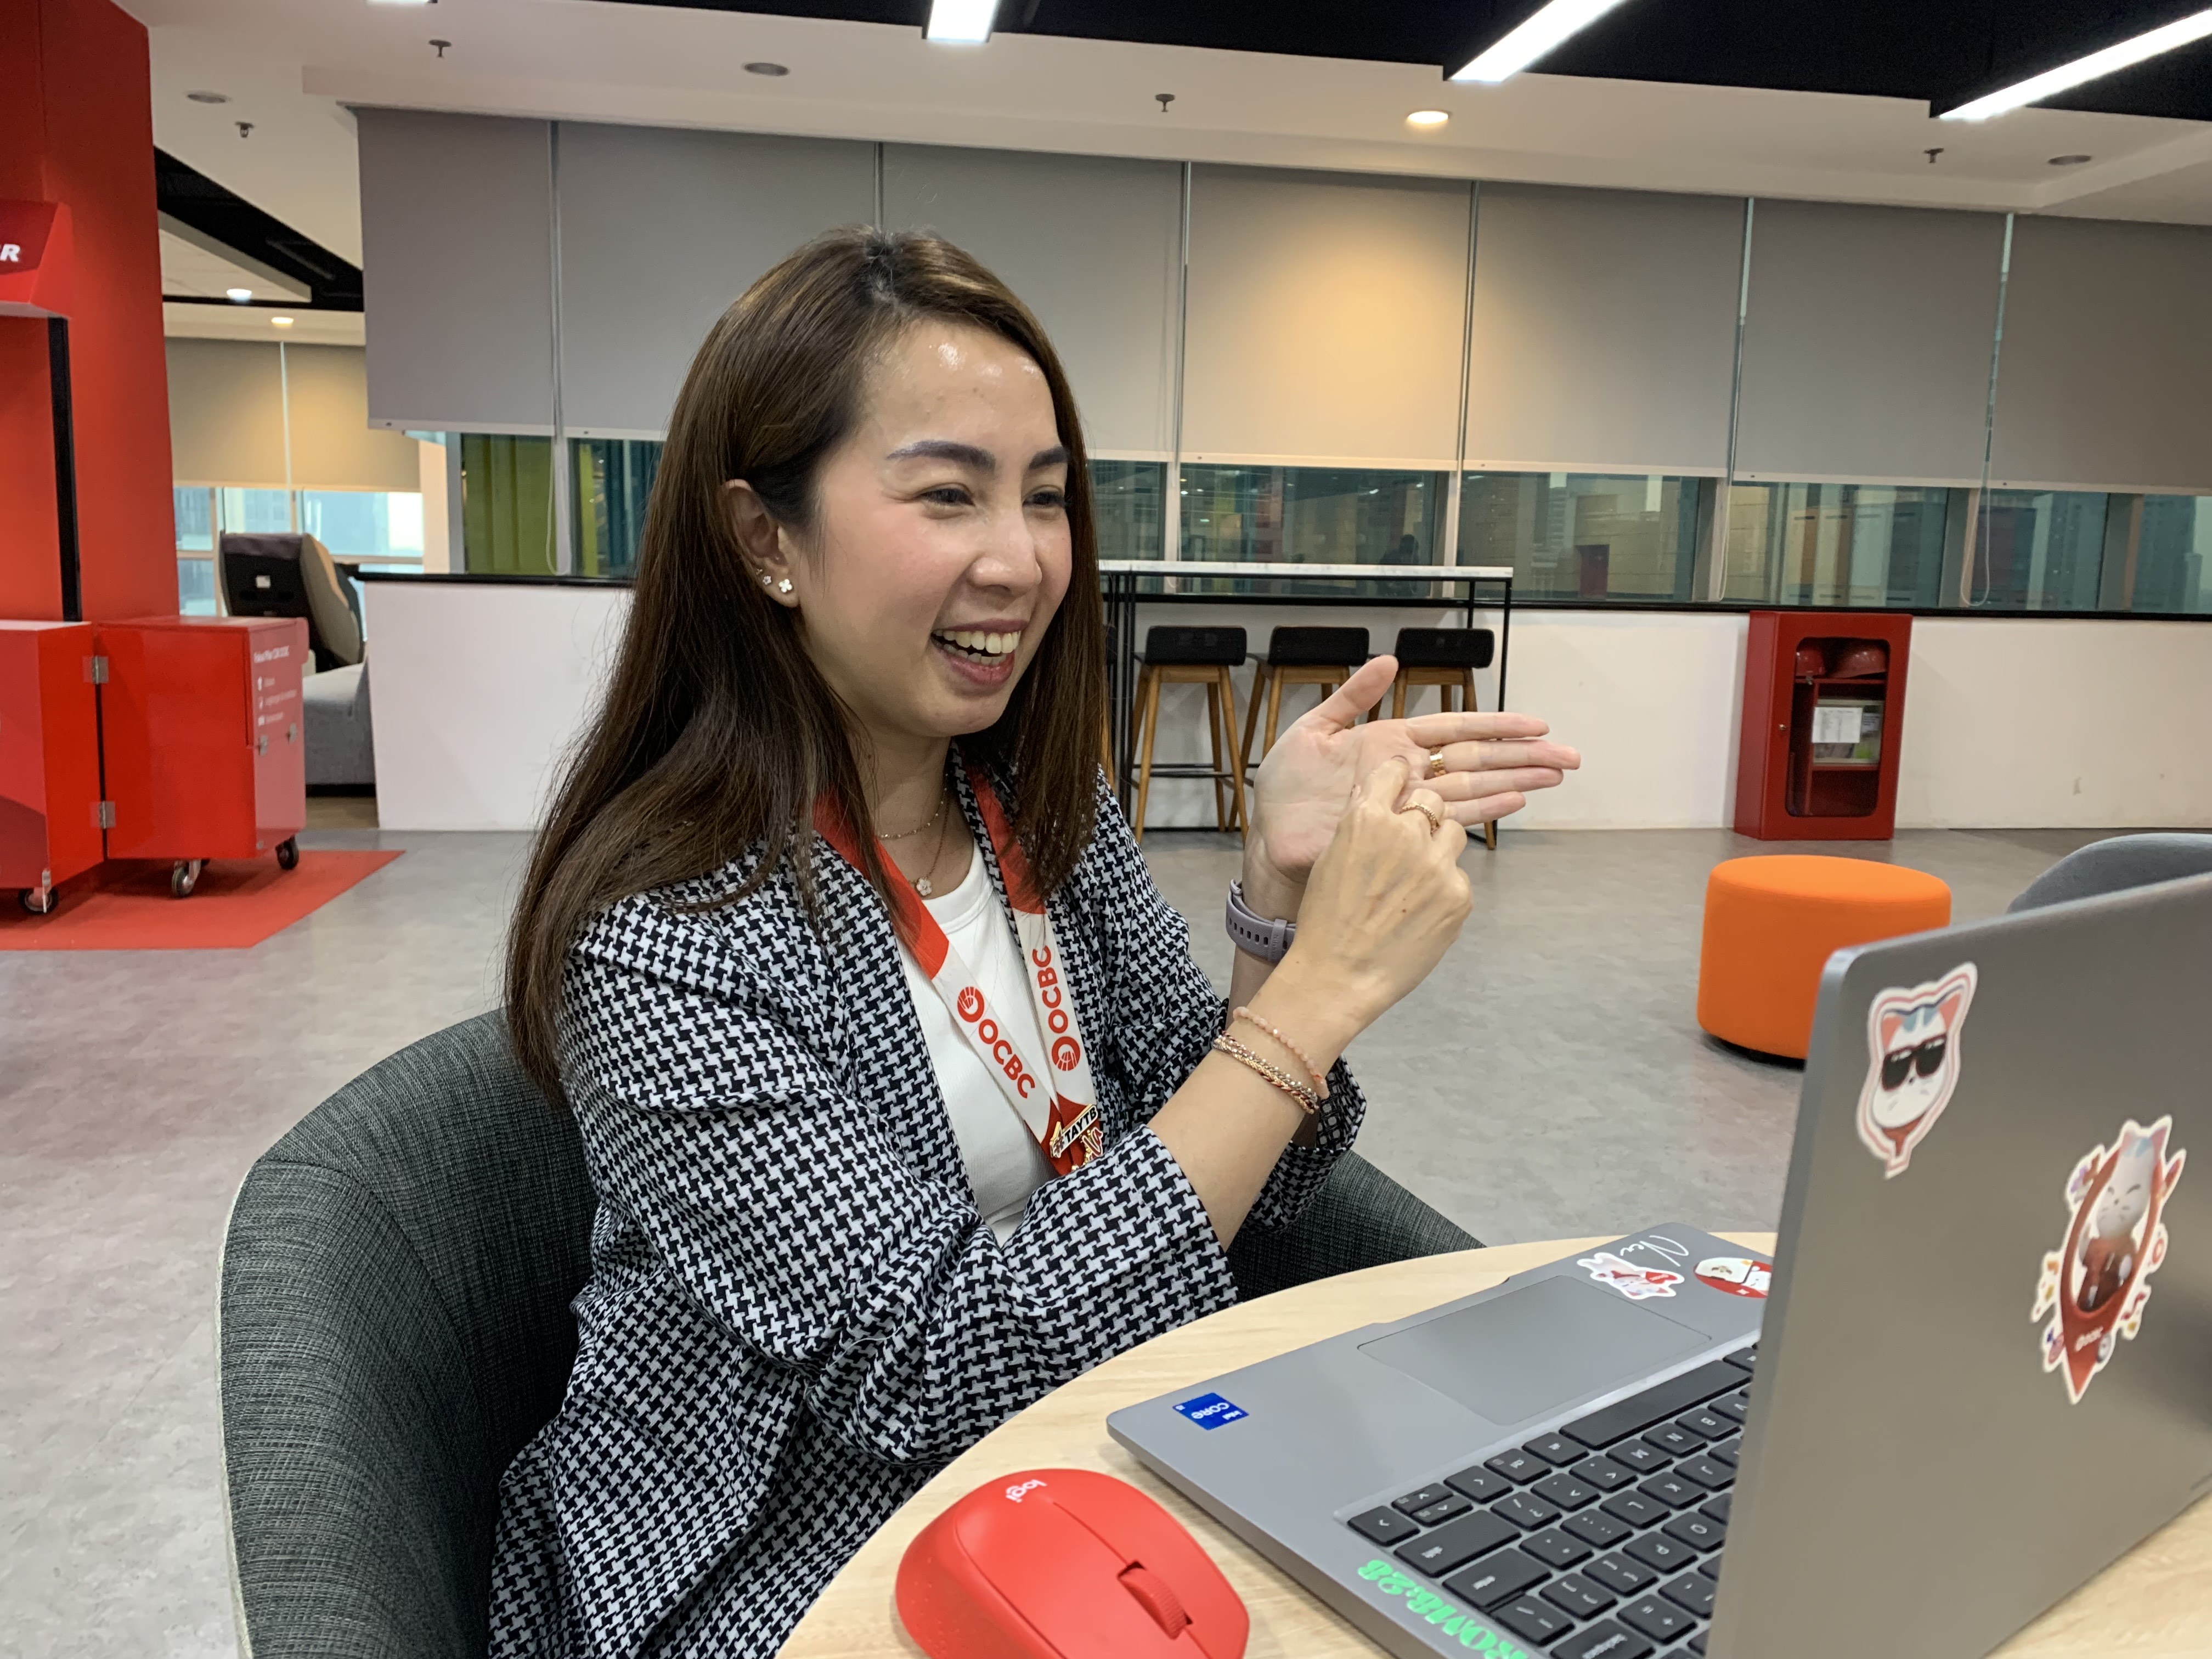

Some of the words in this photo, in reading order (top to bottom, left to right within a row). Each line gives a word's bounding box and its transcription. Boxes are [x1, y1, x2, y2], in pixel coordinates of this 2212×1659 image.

[0, 244, 20, 262] R
[1032, 945, 1069, 1034] OCBC
[978, 1019, 1035, 1098] OCBC
[1006, 1479, 1047, 1503] logi
